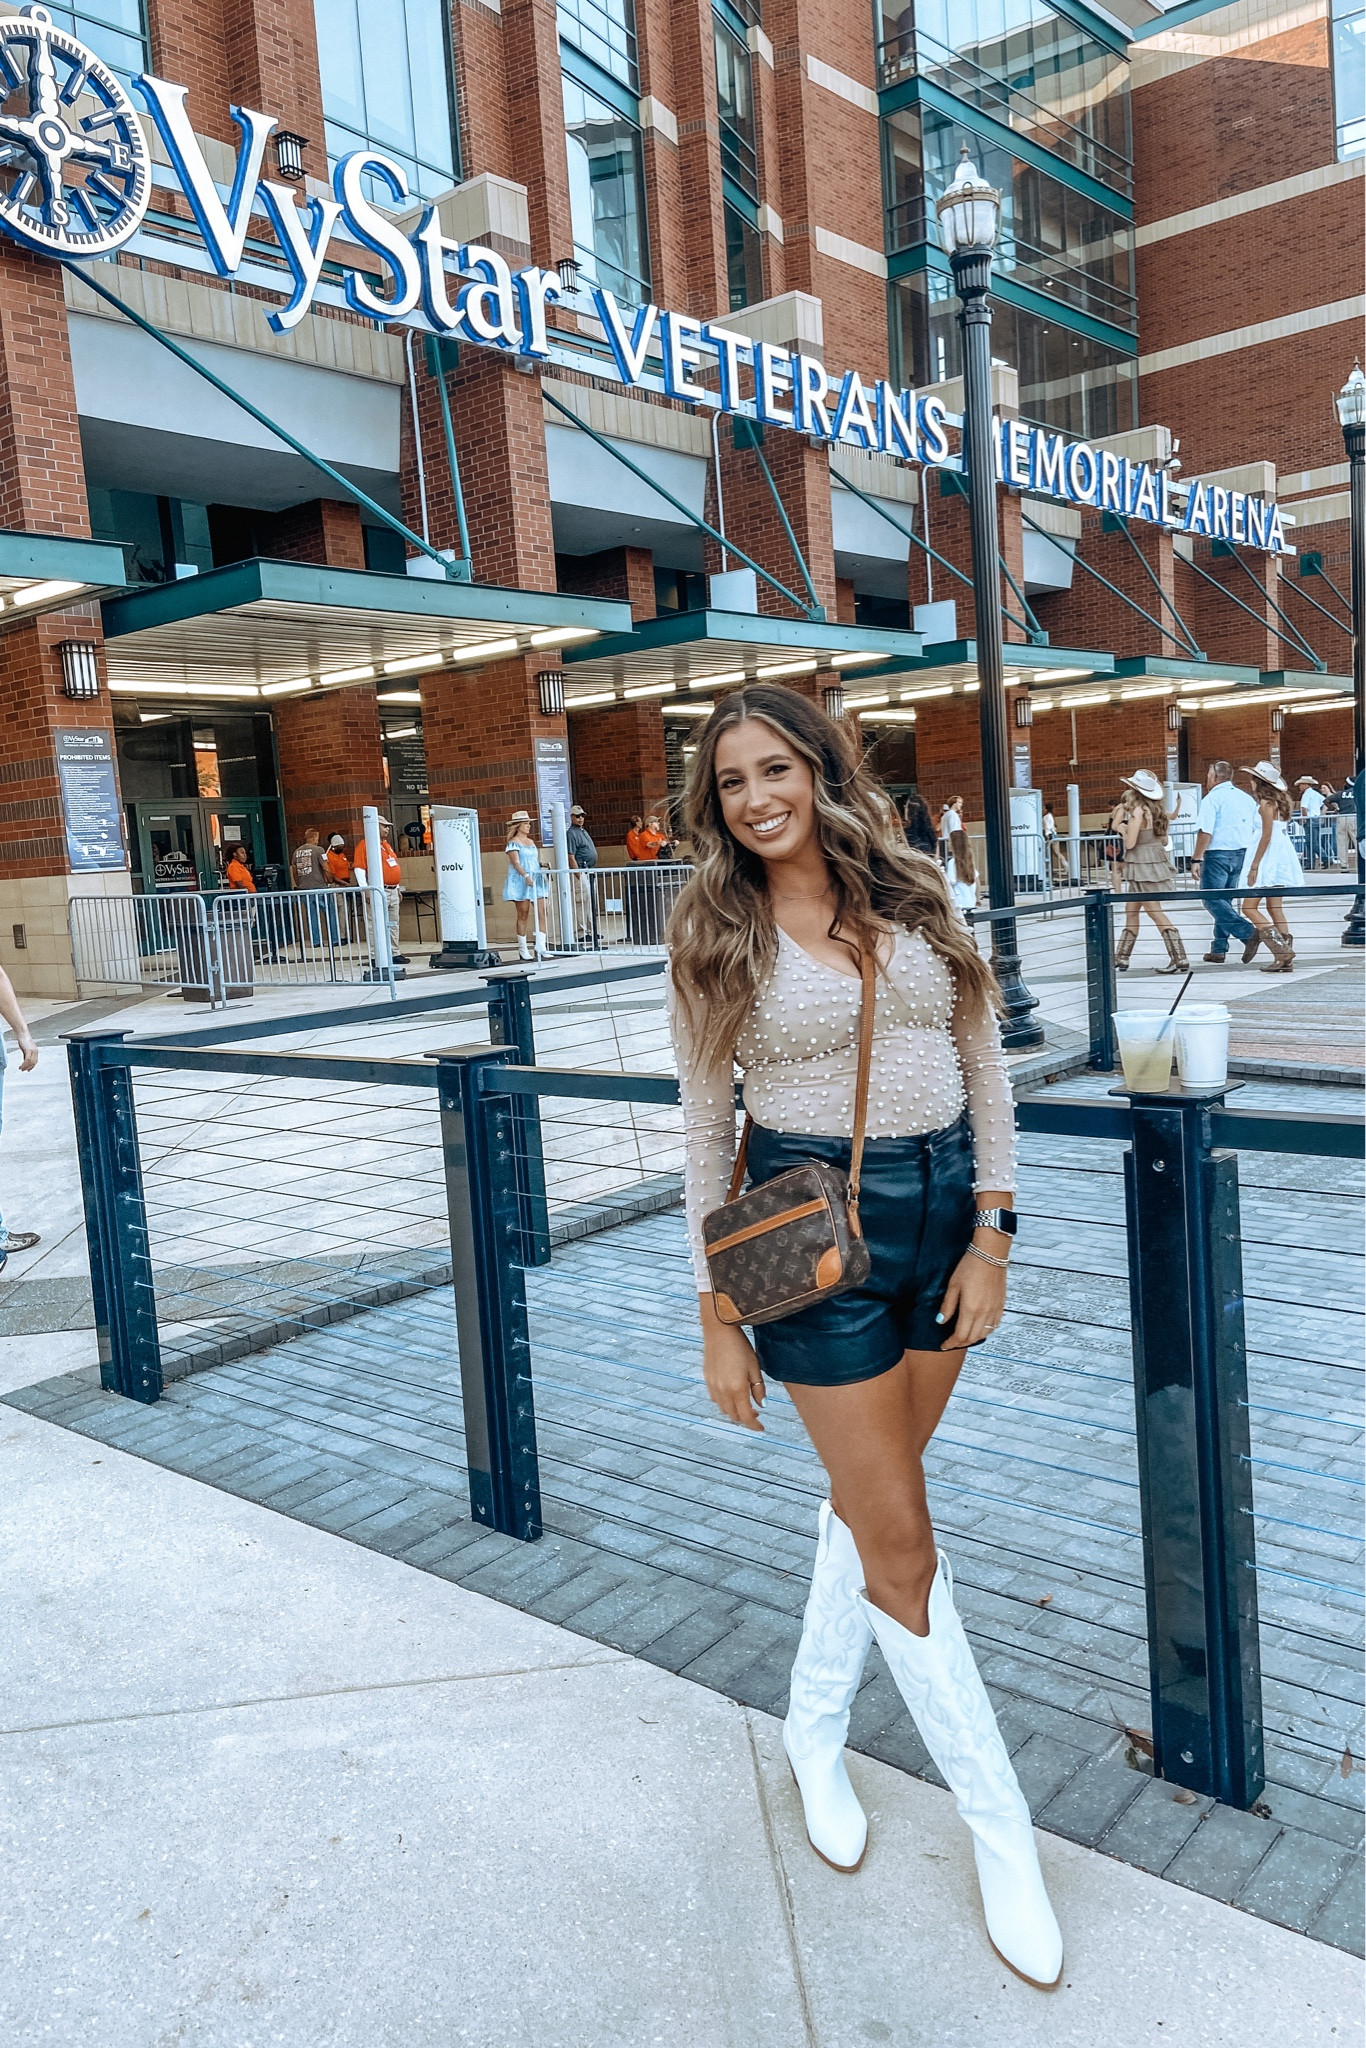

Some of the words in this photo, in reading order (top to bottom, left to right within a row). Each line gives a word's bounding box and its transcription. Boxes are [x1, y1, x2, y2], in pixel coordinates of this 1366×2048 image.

[135, 73, 562, 357] VyStar
[591, 286, 949, 466] VETERANS
[1185, 480, 1286, 552] ARENA
[165, 863, 194, 877] VyStar
[441, 862, 465, 872] evolv
